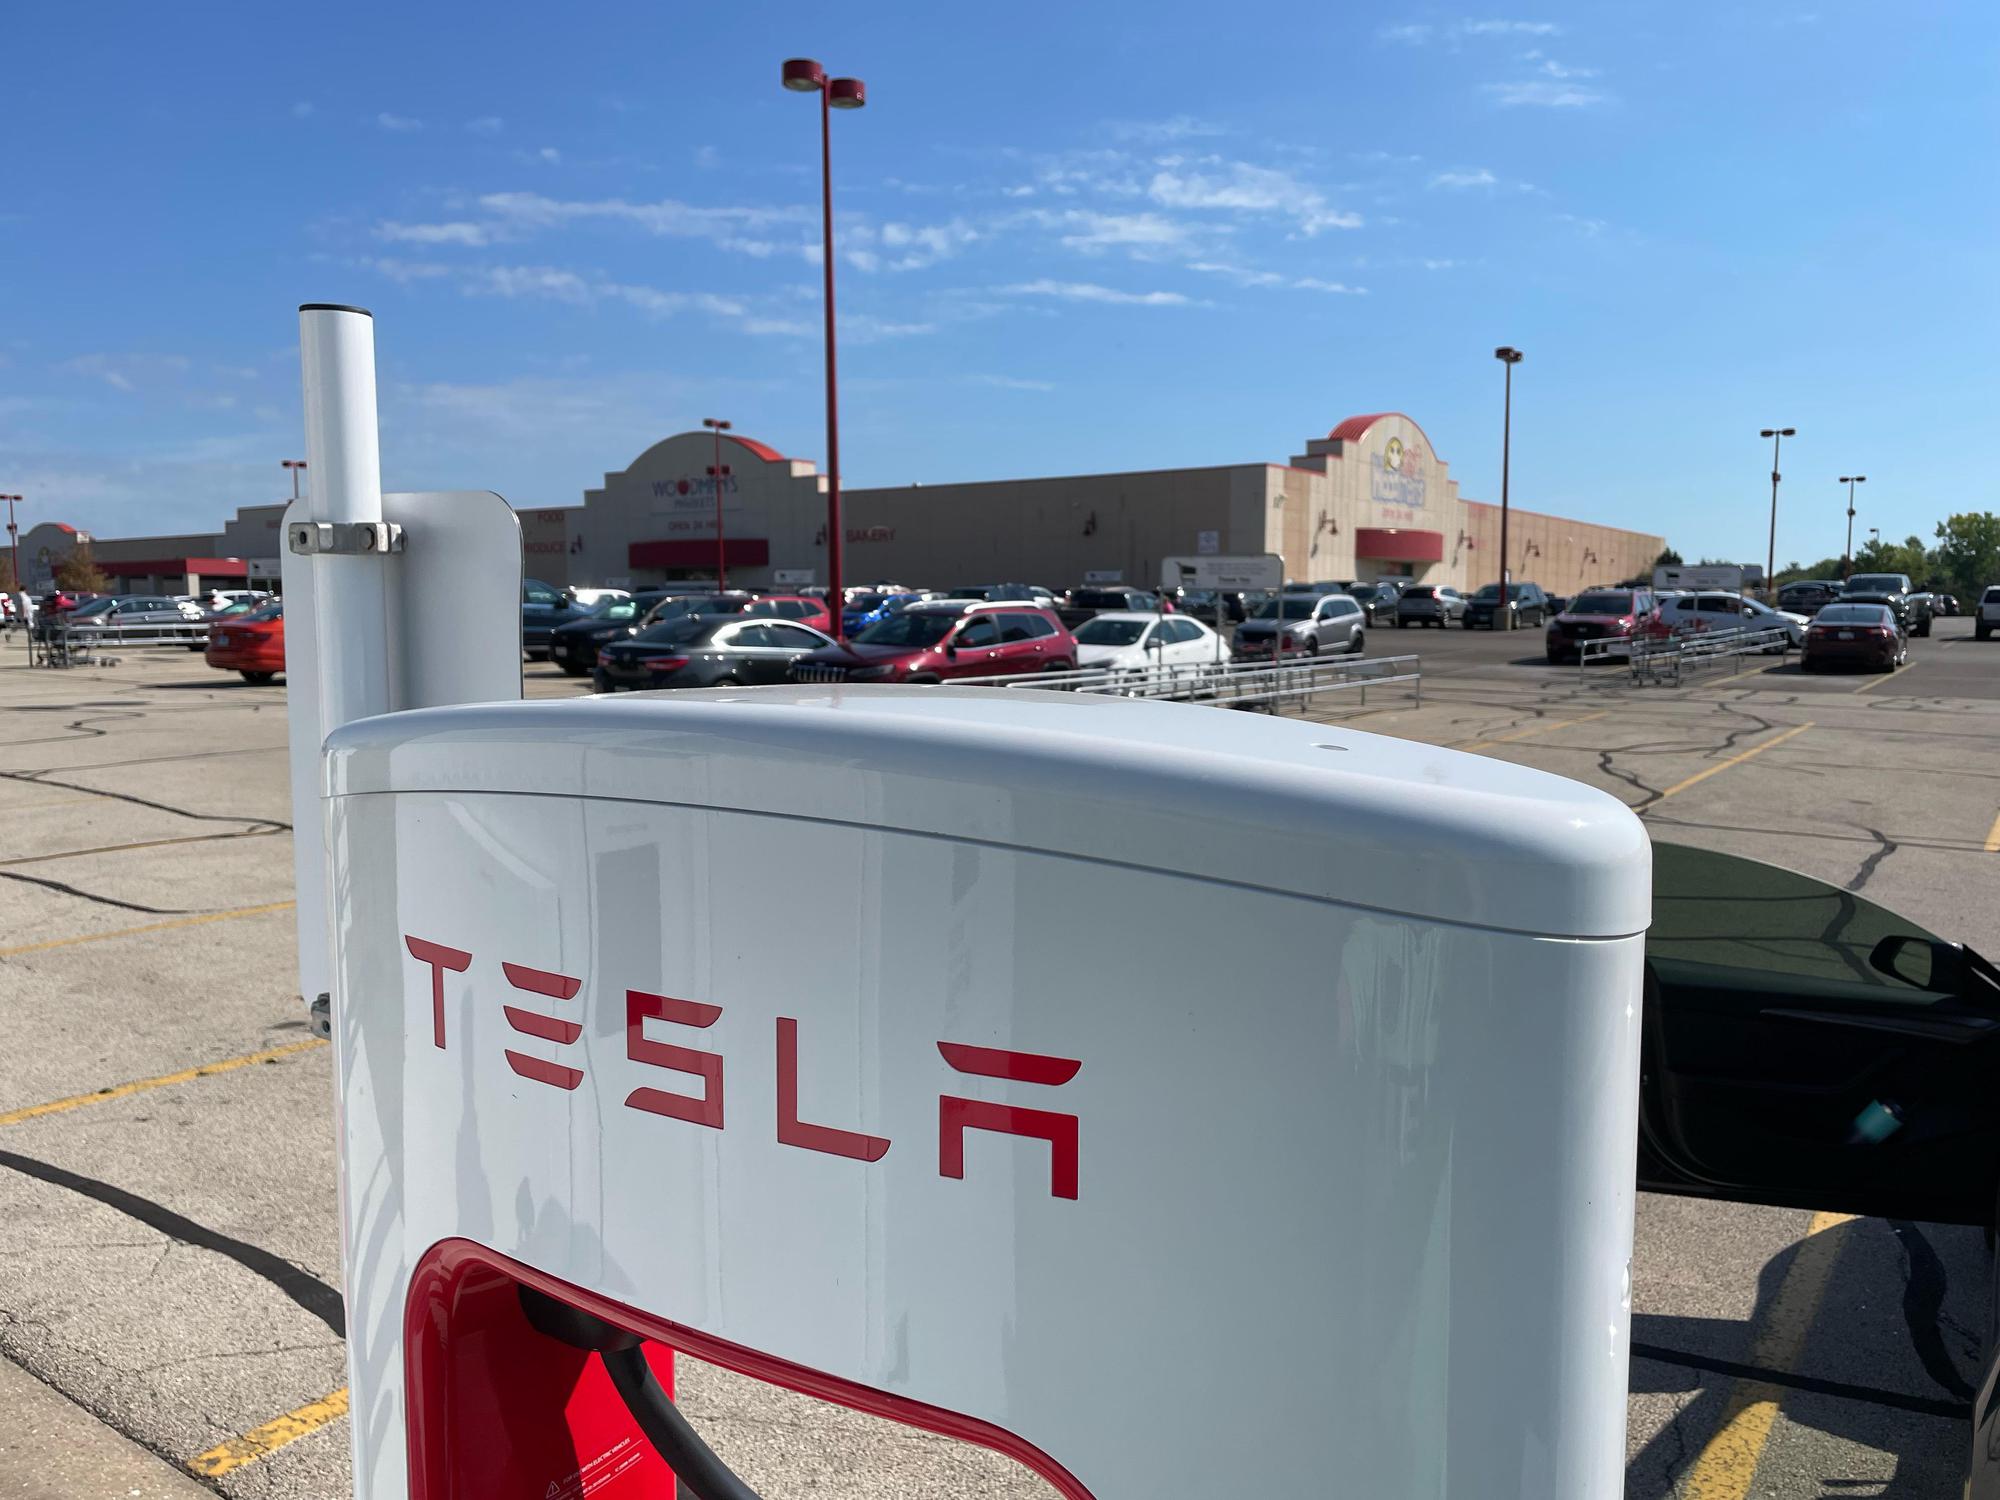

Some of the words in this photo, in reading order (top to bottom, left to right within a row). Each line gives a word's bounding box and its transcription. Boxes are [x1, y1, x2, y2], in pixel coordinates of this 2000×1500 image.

[537, 511, 565, 521] FOOD
[846, 528, 896, 544] BAKERY
[404, 934, 1083, 1201] TESLA
[593, 1449, 612, 1466] ELECTRIC
[611, 1437, 631, 1454] VEHICLES
